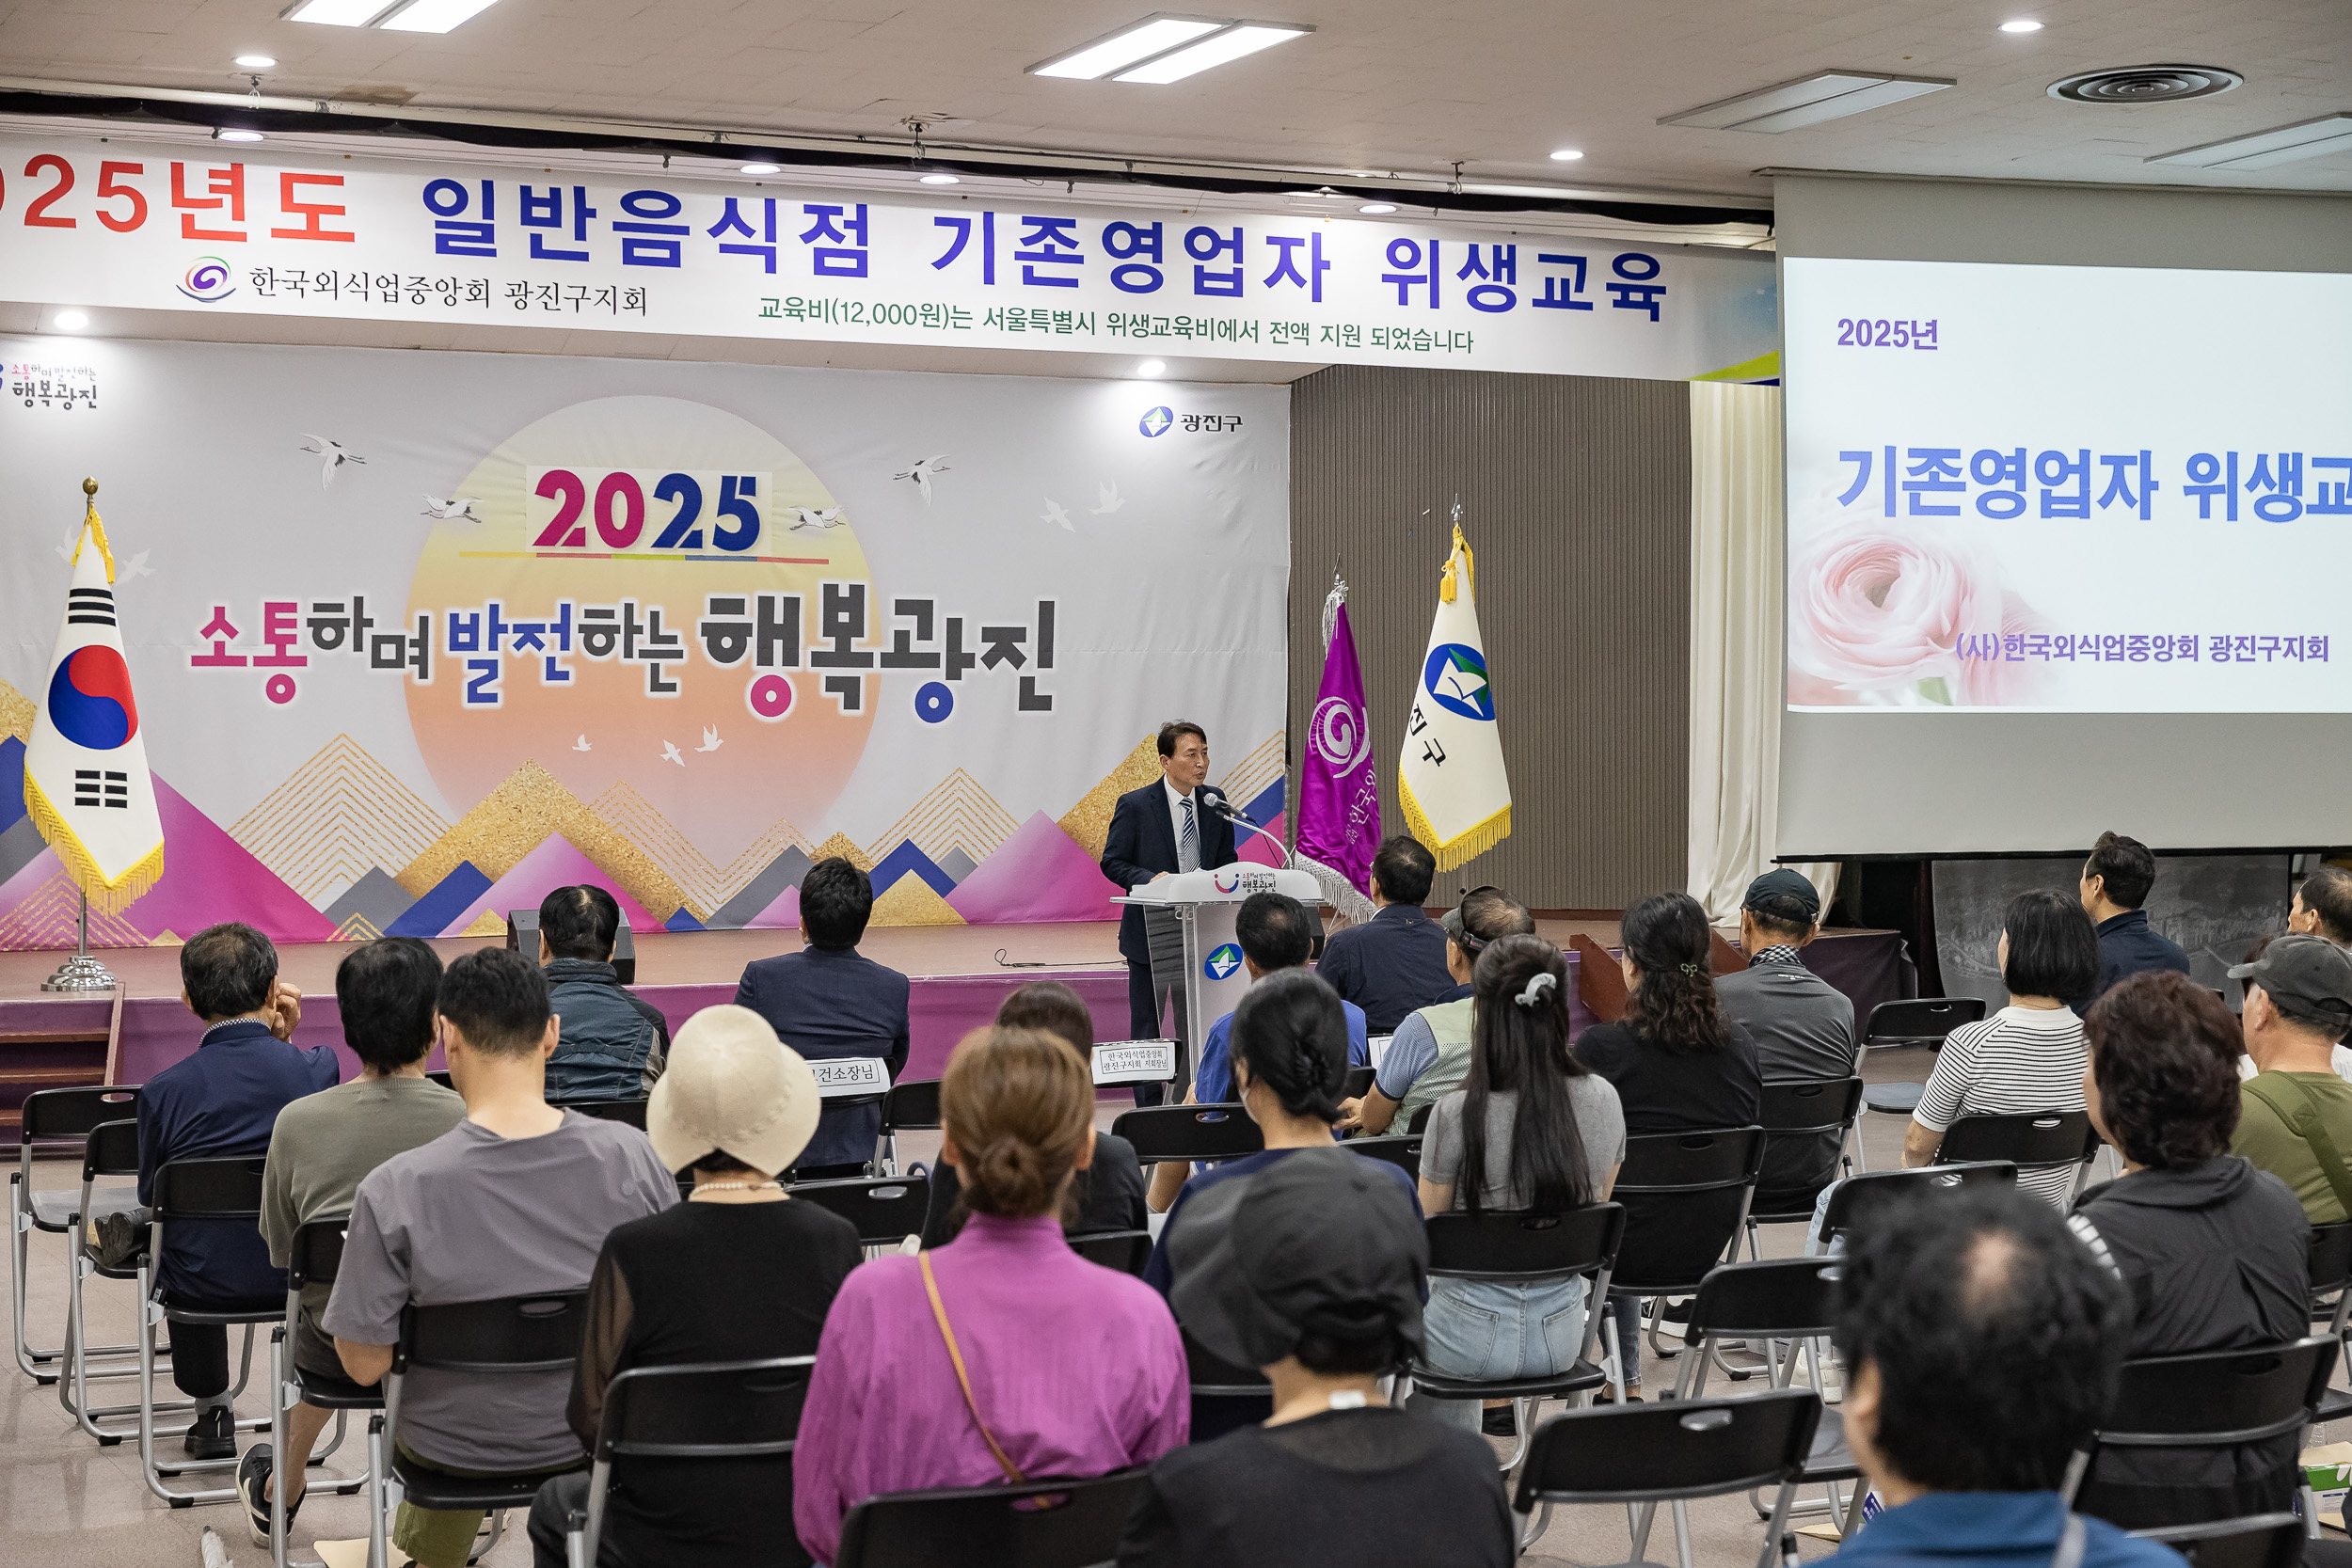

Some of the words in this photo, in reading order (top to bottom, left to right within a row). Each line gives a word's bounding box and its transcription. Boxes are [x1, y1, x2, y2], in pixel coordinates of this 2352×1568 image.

[0, 153, 356, 243] 25년도
[422, 178, 869, 278] 일반음식점
[931, 211, 1331, 304] 기존영업자
[1381, 237, 1667, 323] 위생교육
[249, 266, 490, 309] 한국외식업중앙회
[503, 280, 647, 318] 광진구지회
[758, 296, 974, 329] 교육비(12,000원)는
[982, 307, 1096, 336] 서울특별시
[1106, 312, 1260, 344] 위생교육비에서
[1269, 321, 1311, 346] 전액
[1320, 324, 1361, 348] 지원
[1371, 327, 1474, 355] 되었습니다
[1836, 318, 1938, 351] 2025년
[12, 380, 97, 410] 행복광진
[1180, 413, 1244, 434] 광진구
[1836, 445, 2160, 521] 기존영업자
[532, 468, 761, 552] 2025
[189, 595, 430, 705] 소통하며
[448, 601, 685, 704] 발전하는
[700, 583, 1056, 723] 행복광진
[1955, 632, 2200, 664] (사)한국외식업중앙회
[2208, 634, 2329, 663] 광진구지회
[1242, 879, 1276, 893] 행복광진
[1103, 1059, 1141, 1071] 광진구지회
[1107, 1050, 1163, 1061] 한국외식업중앙회
[812, 1064, 873, 1083] 건소장님
